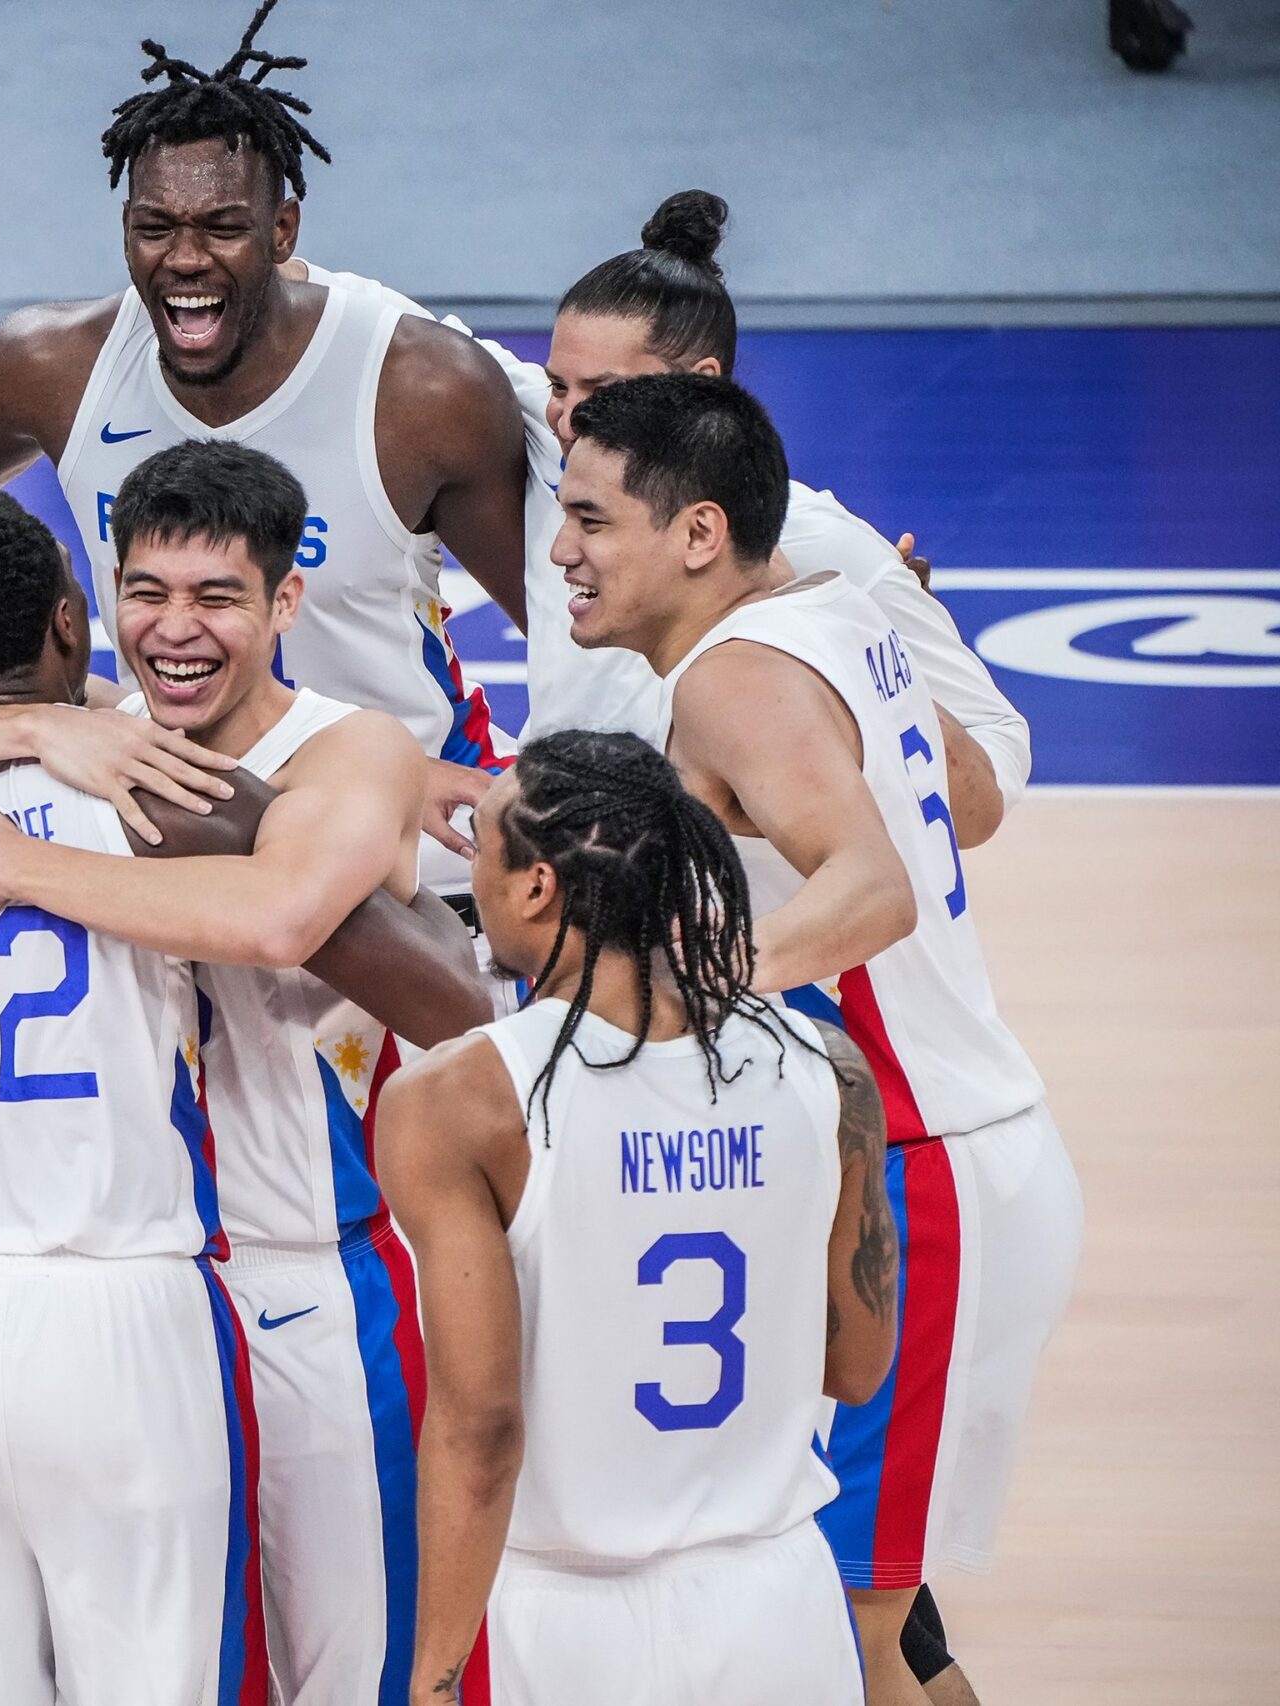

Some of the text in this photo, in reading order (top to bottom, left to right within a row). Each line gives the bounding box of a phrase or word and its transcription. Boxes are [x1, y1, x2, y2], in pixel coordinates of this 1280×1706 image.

[865, 628, 912, 703] ALAS
[621, 1125, 765, 1194] NEWSOME
[635, 1231, 746, 1432] 3
